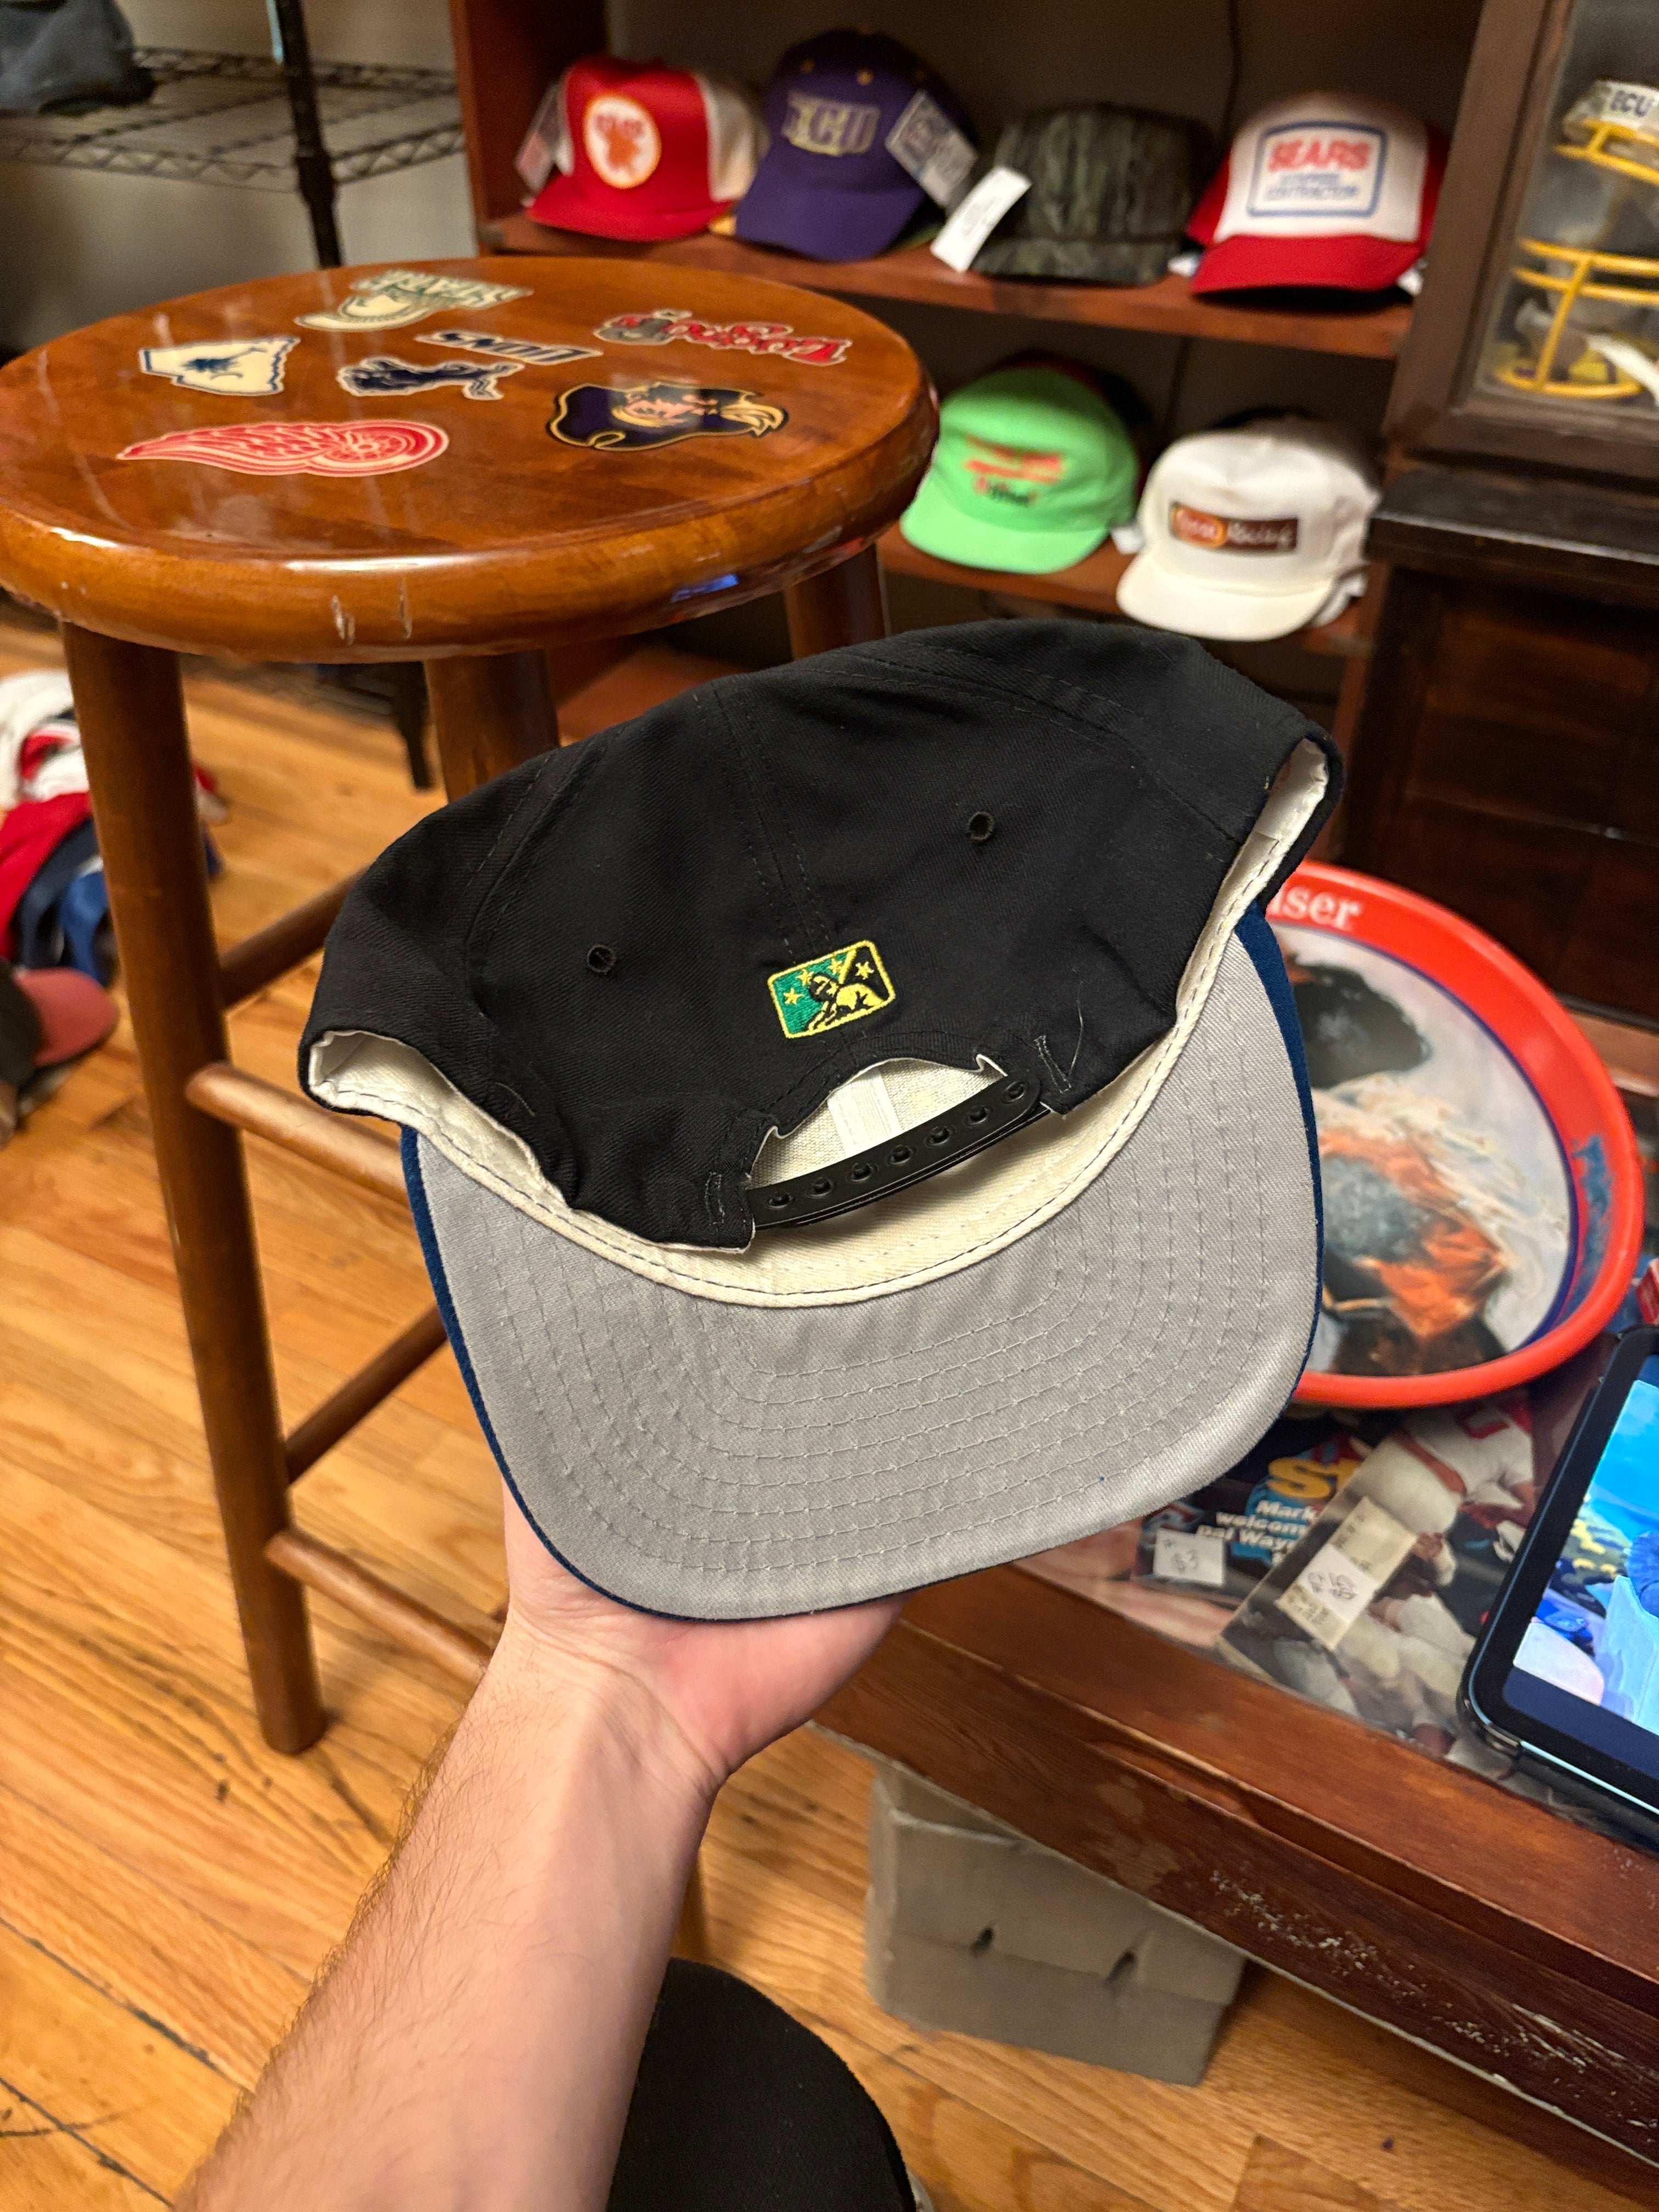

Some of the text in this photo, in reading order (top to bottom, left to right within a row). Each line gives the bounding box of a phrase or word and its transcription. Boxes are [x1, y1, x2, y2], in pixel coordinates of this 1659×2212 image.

[1610, 89, 1655, 118] ECU
[1268, 138, 1370, 173] SEARS
[1256, 1500, 1318, 1520] Mark
